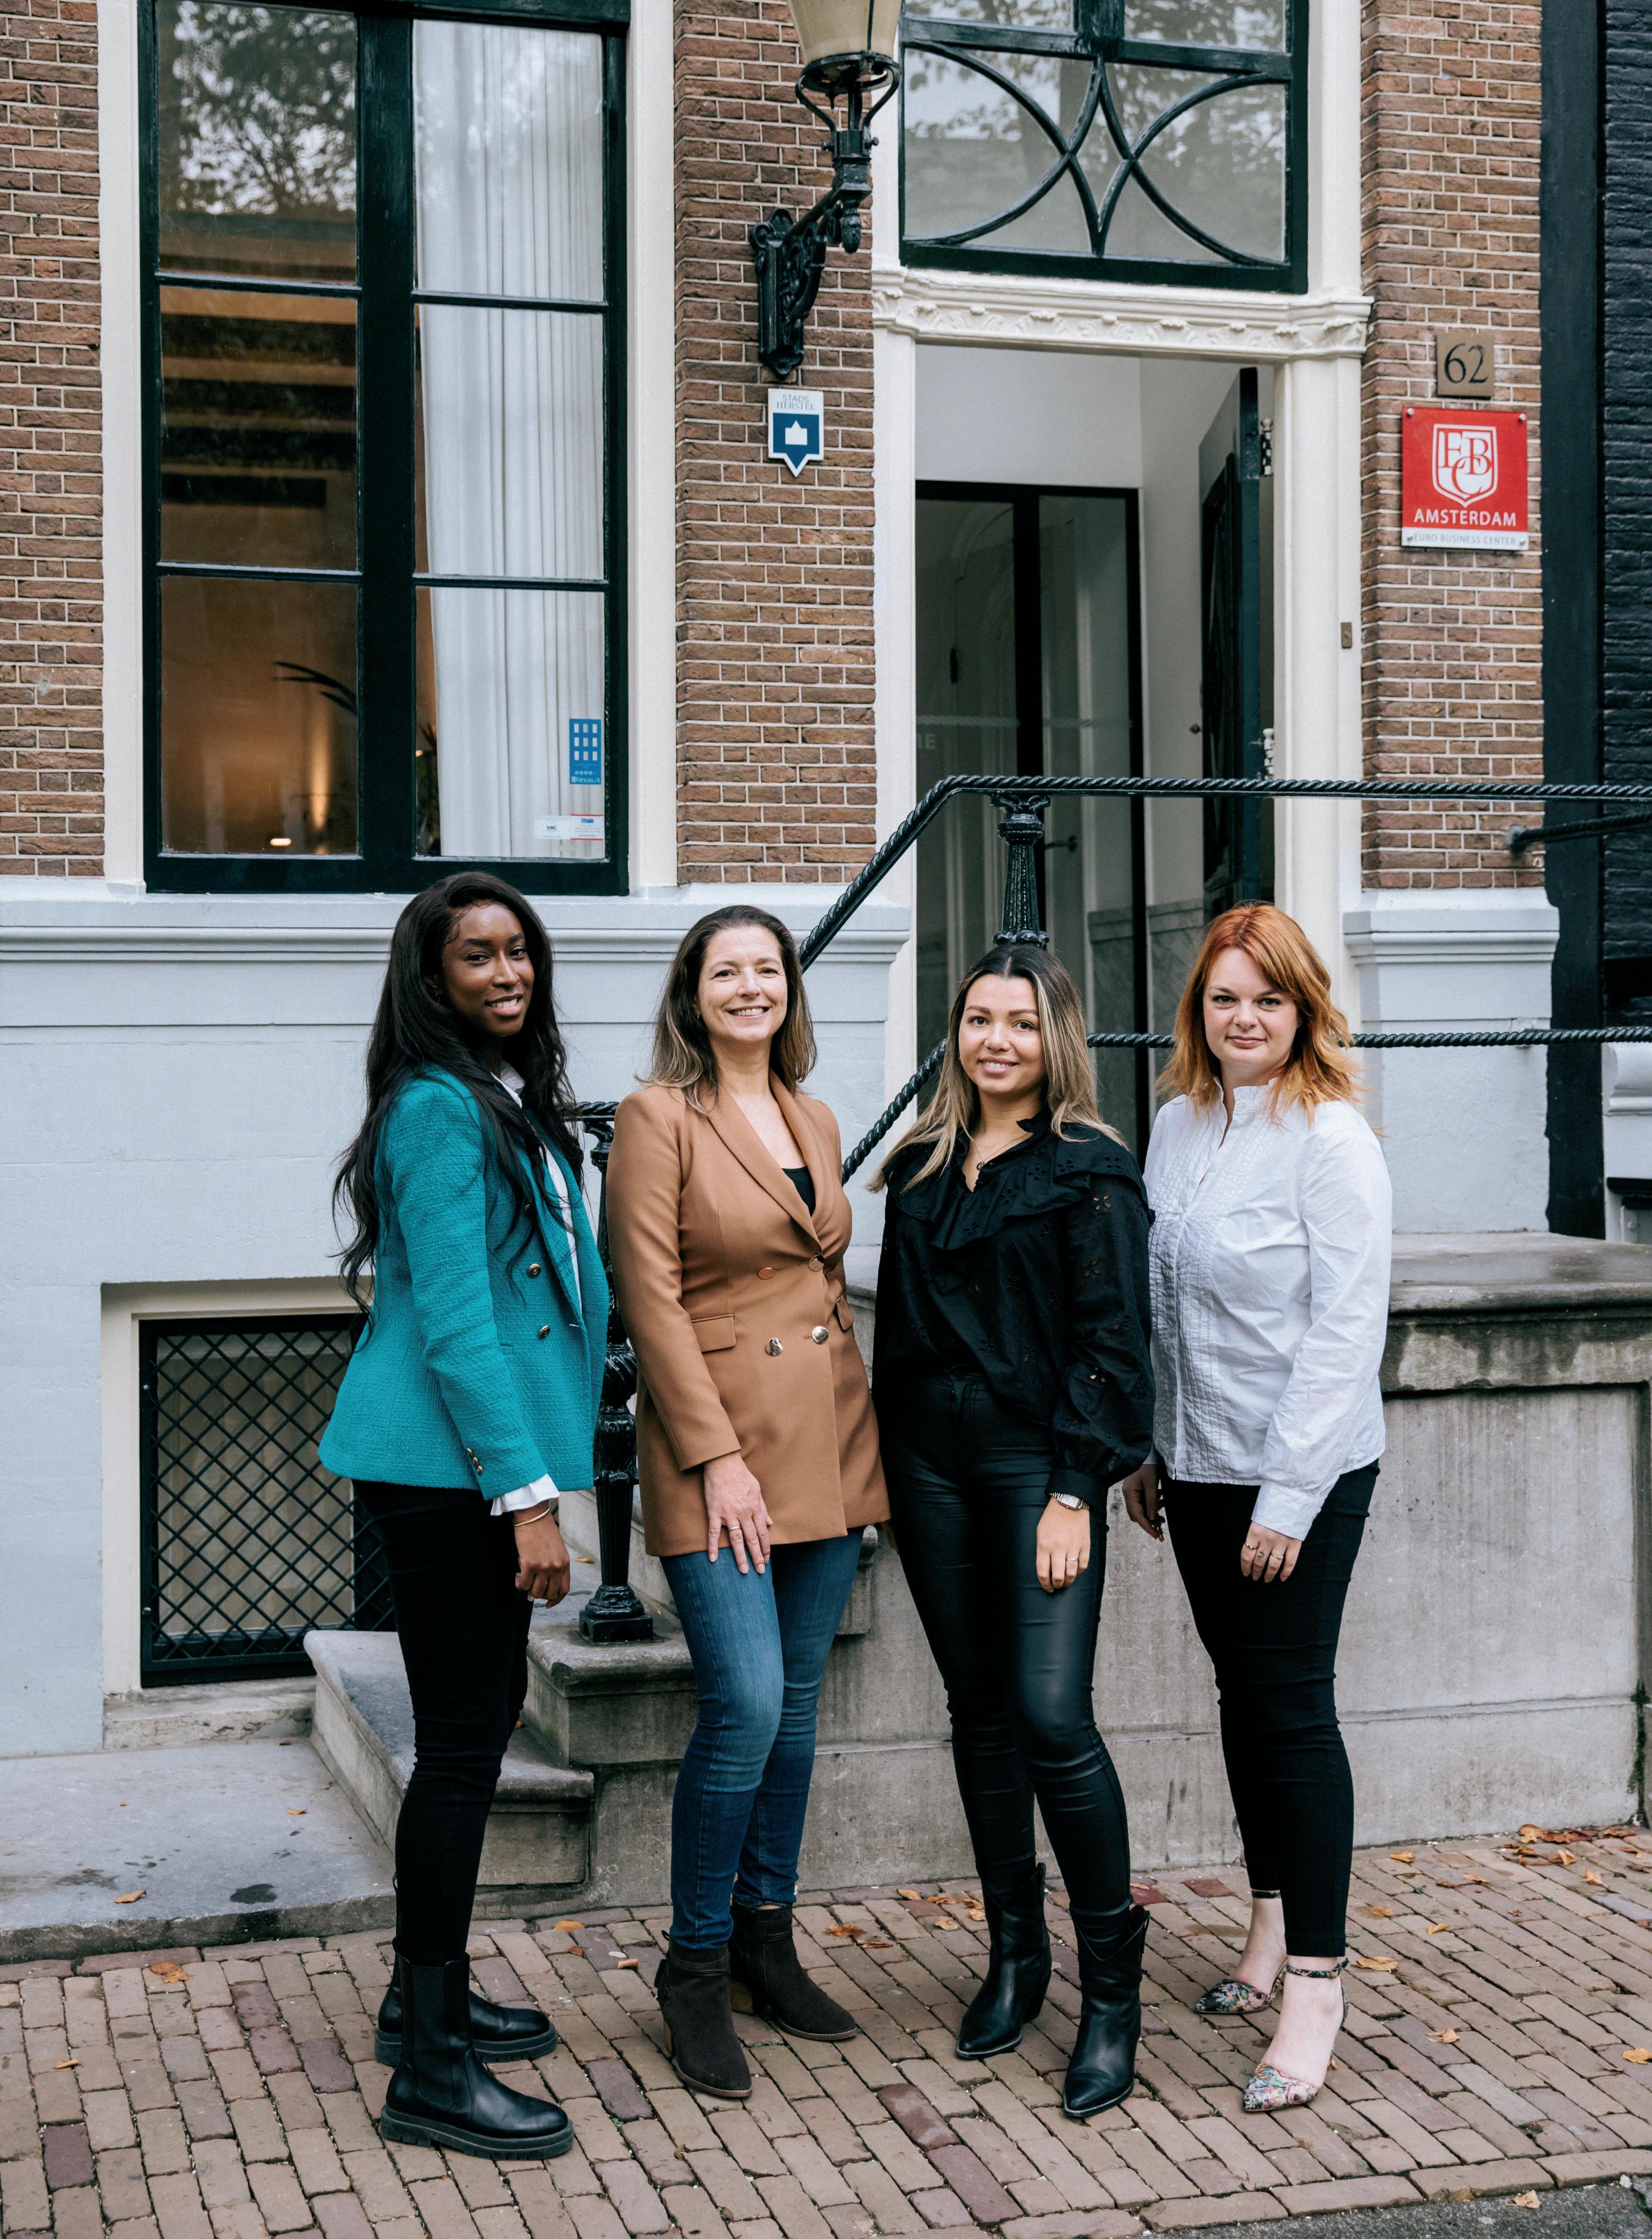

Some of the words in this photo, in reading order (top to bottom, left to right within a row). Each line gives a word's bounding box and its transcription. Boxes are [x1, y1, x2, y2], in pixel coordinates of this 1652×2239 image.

[1444, 343, 1488, 384] 62
[782, 394, 809, 402] STADS
[776, 401, 816, 411] HERSTEL
[1413, 508, 1517, 527] AMSTERDAM
[1414, 533, 1437, 542] EURO
[1440, 534, 1481, 544] BUSINESS
[1483, 536, 1516, 546] CENTER
